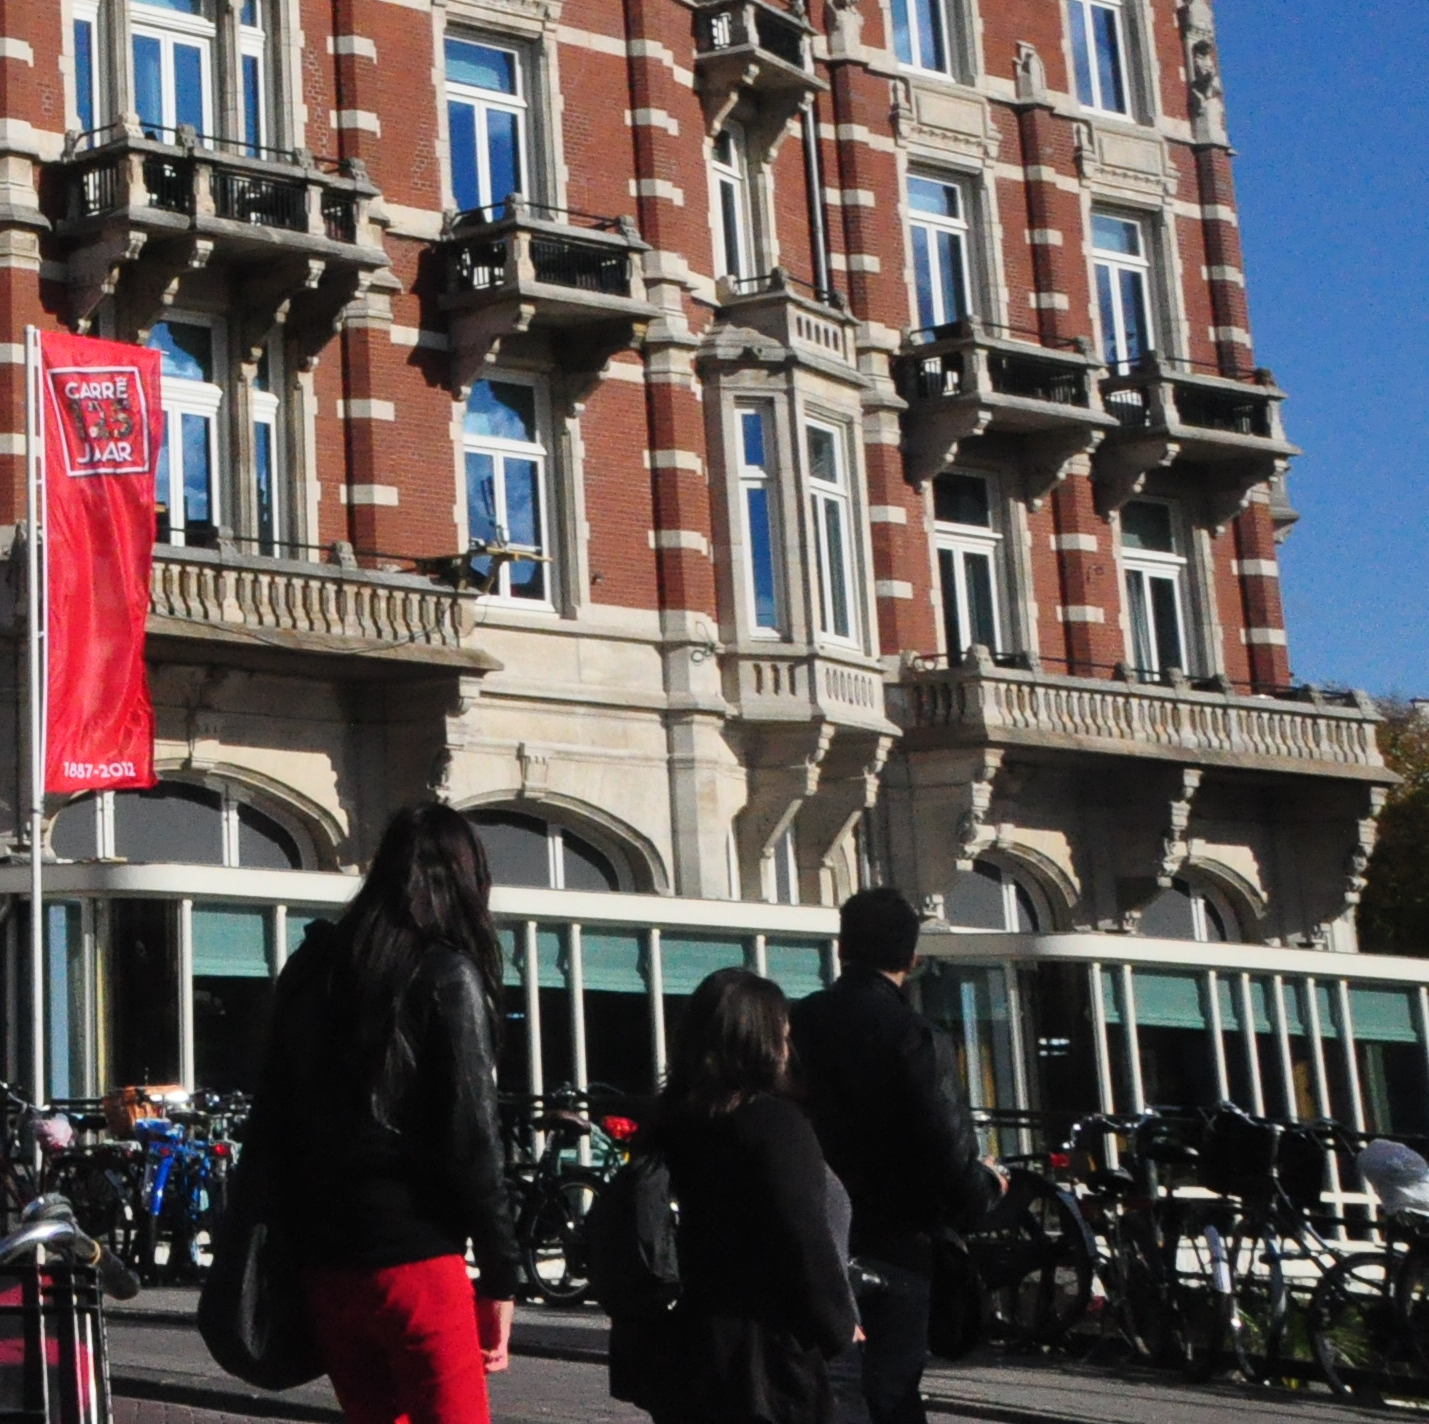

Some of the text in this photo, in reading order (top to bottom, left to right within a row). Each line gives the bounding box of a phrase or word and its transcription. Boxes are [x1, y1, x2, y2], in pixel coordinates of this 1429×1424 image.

[68, 399, 133, 439] 125
[76, 441, 133, 464] JAAR
[63, 761, 137, 779] 1887-2012
